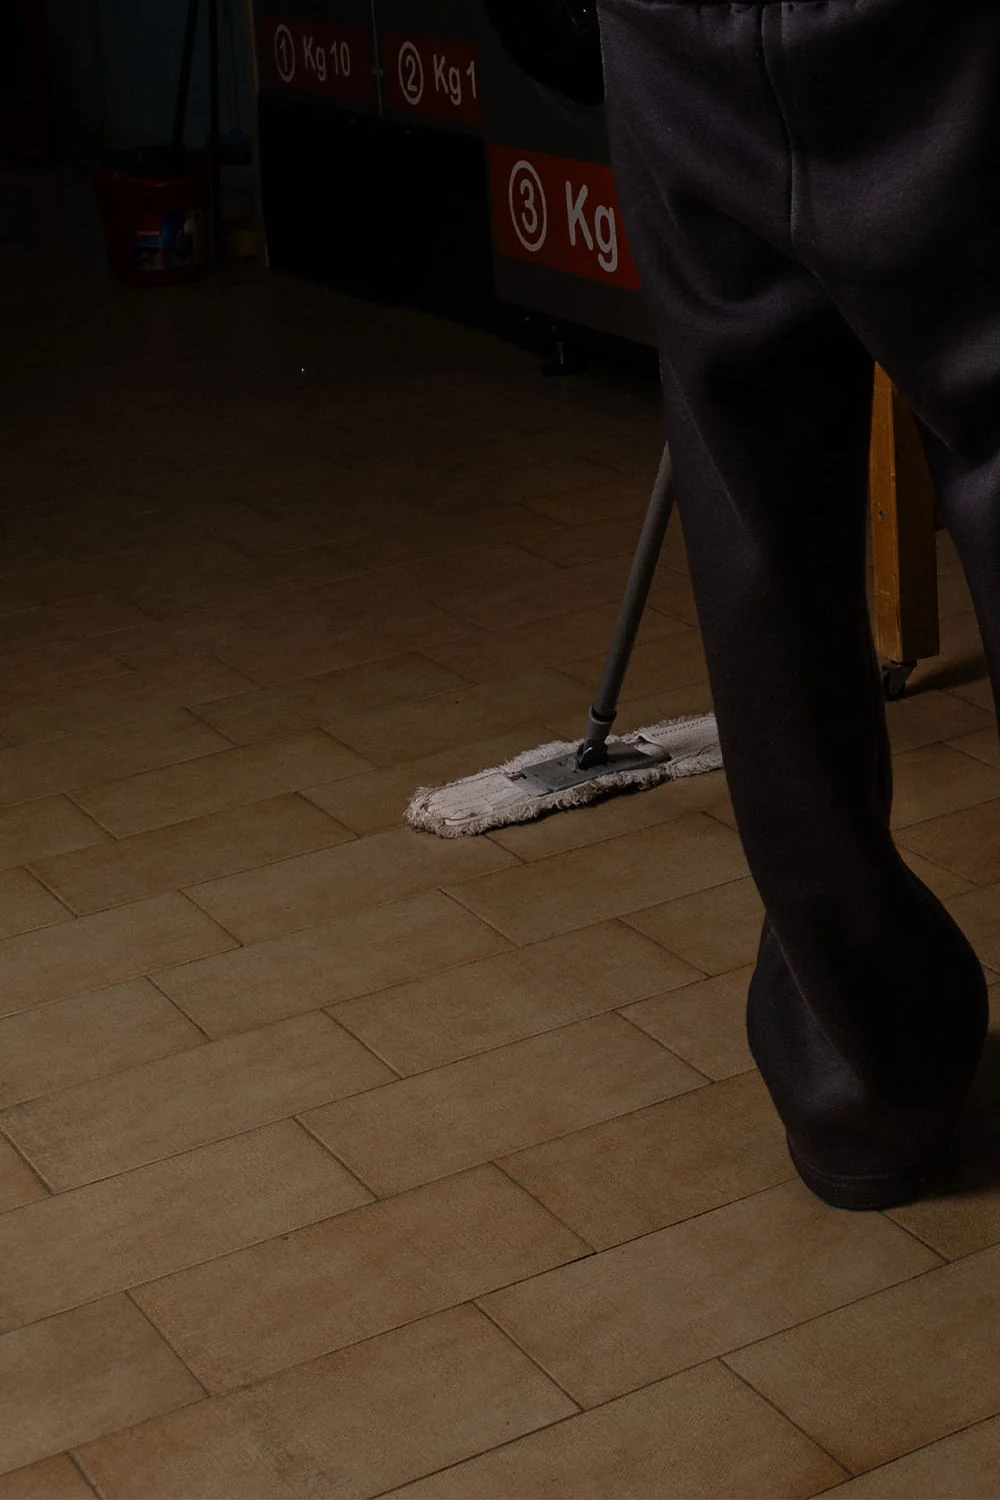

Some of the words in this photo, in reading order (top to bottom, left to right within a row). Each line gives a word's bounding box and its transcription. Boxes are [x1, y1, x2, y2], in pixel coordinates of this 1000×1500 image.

[302, 35, 327, 83] Kg
[328, 40, 351, 78] 10
[432, 53, 462, 107] Kg
[564, 180, 619, 274] Kg
